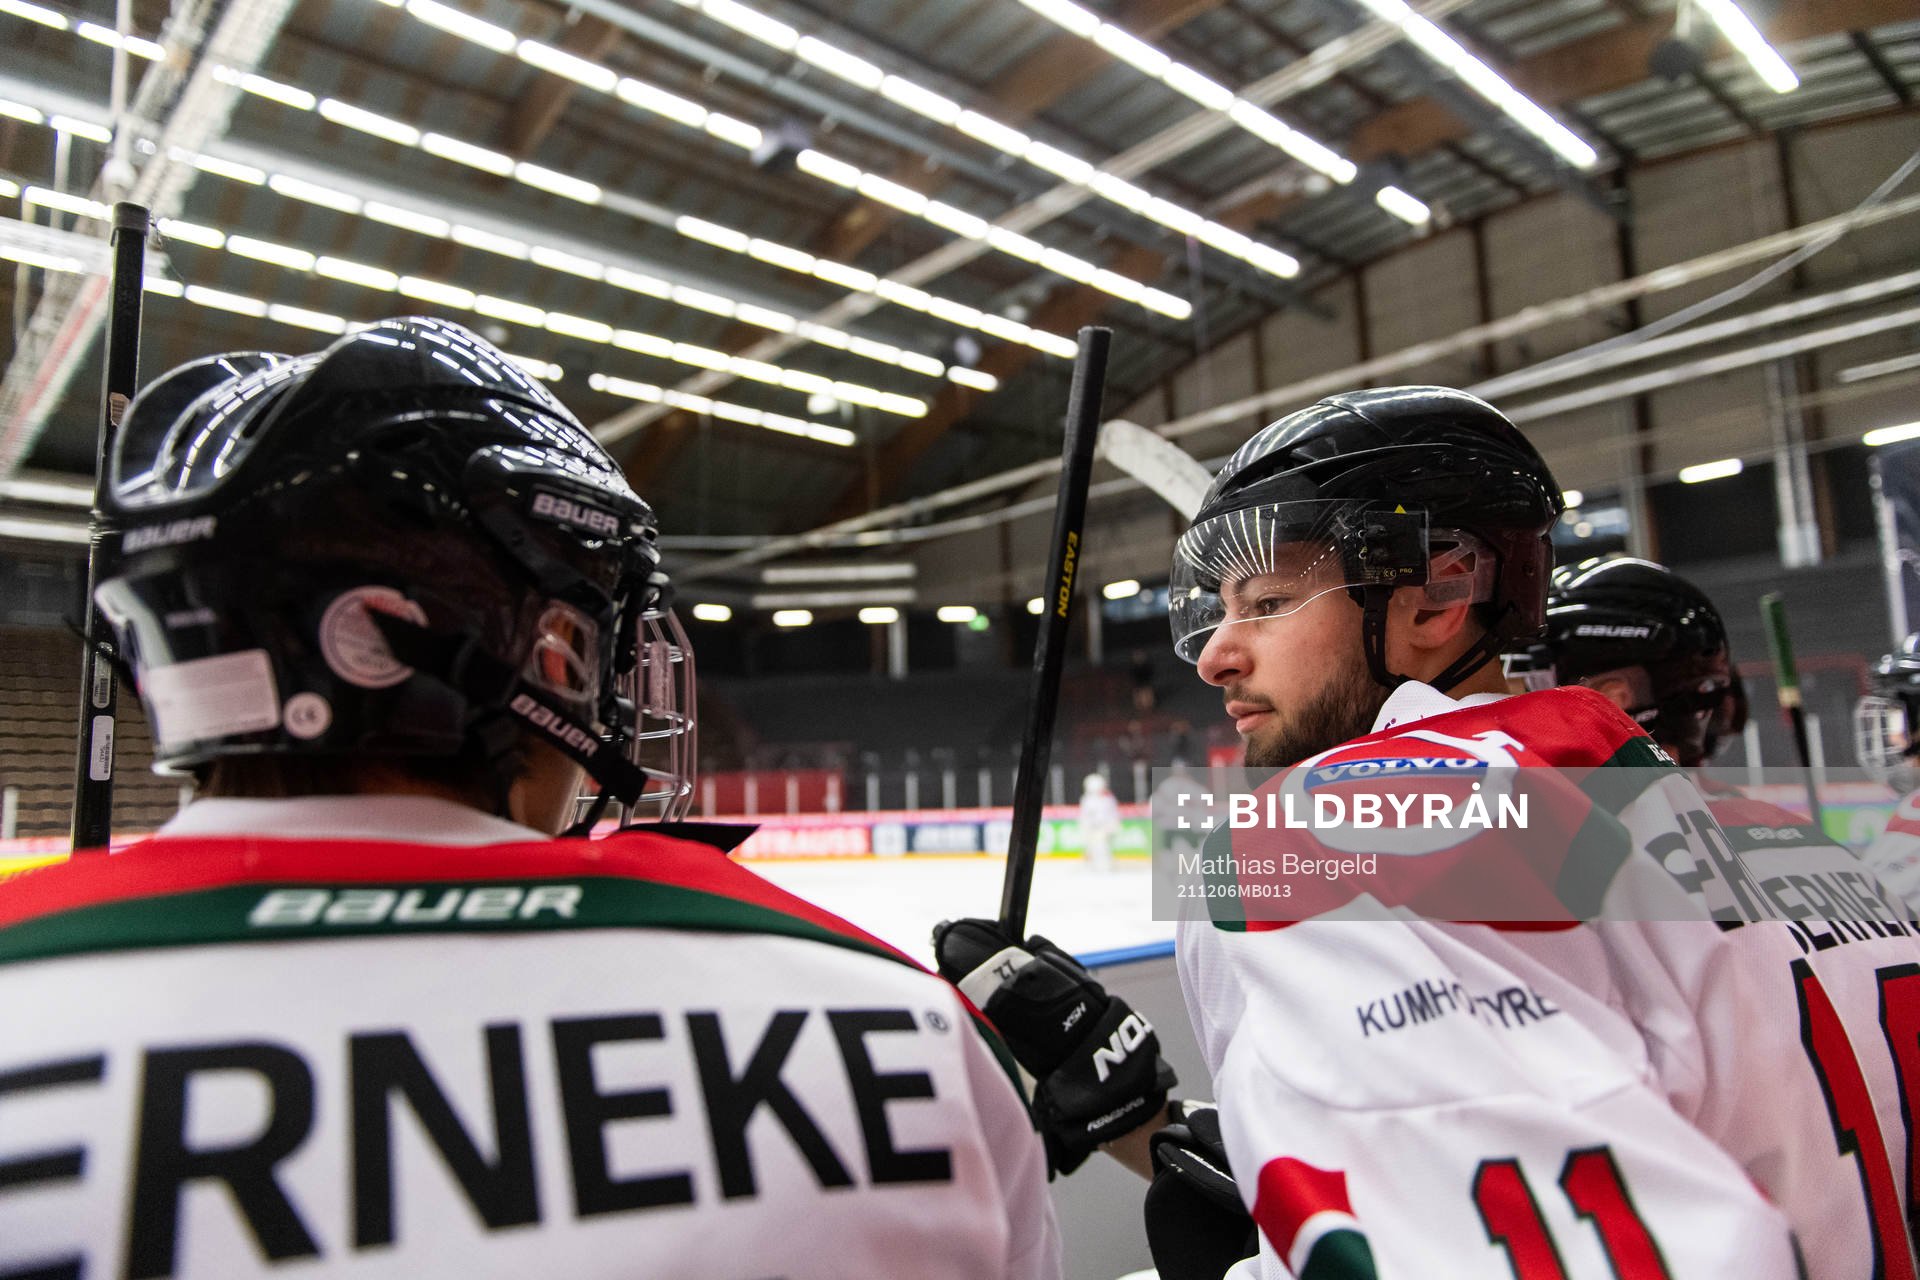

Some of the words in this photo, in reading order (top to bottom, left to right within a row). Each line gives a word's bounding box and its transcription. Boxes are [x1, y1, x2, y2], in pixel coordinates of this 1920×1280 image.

[1057, 531, 1079, 618] EASTON
[1575, 624, 1650, 639] BAUER
[509, 693, 600, 757] BAUER
[1312, 757, 1479, 783] VOLVO
[1469, 1144, 1675, 1280] 11
